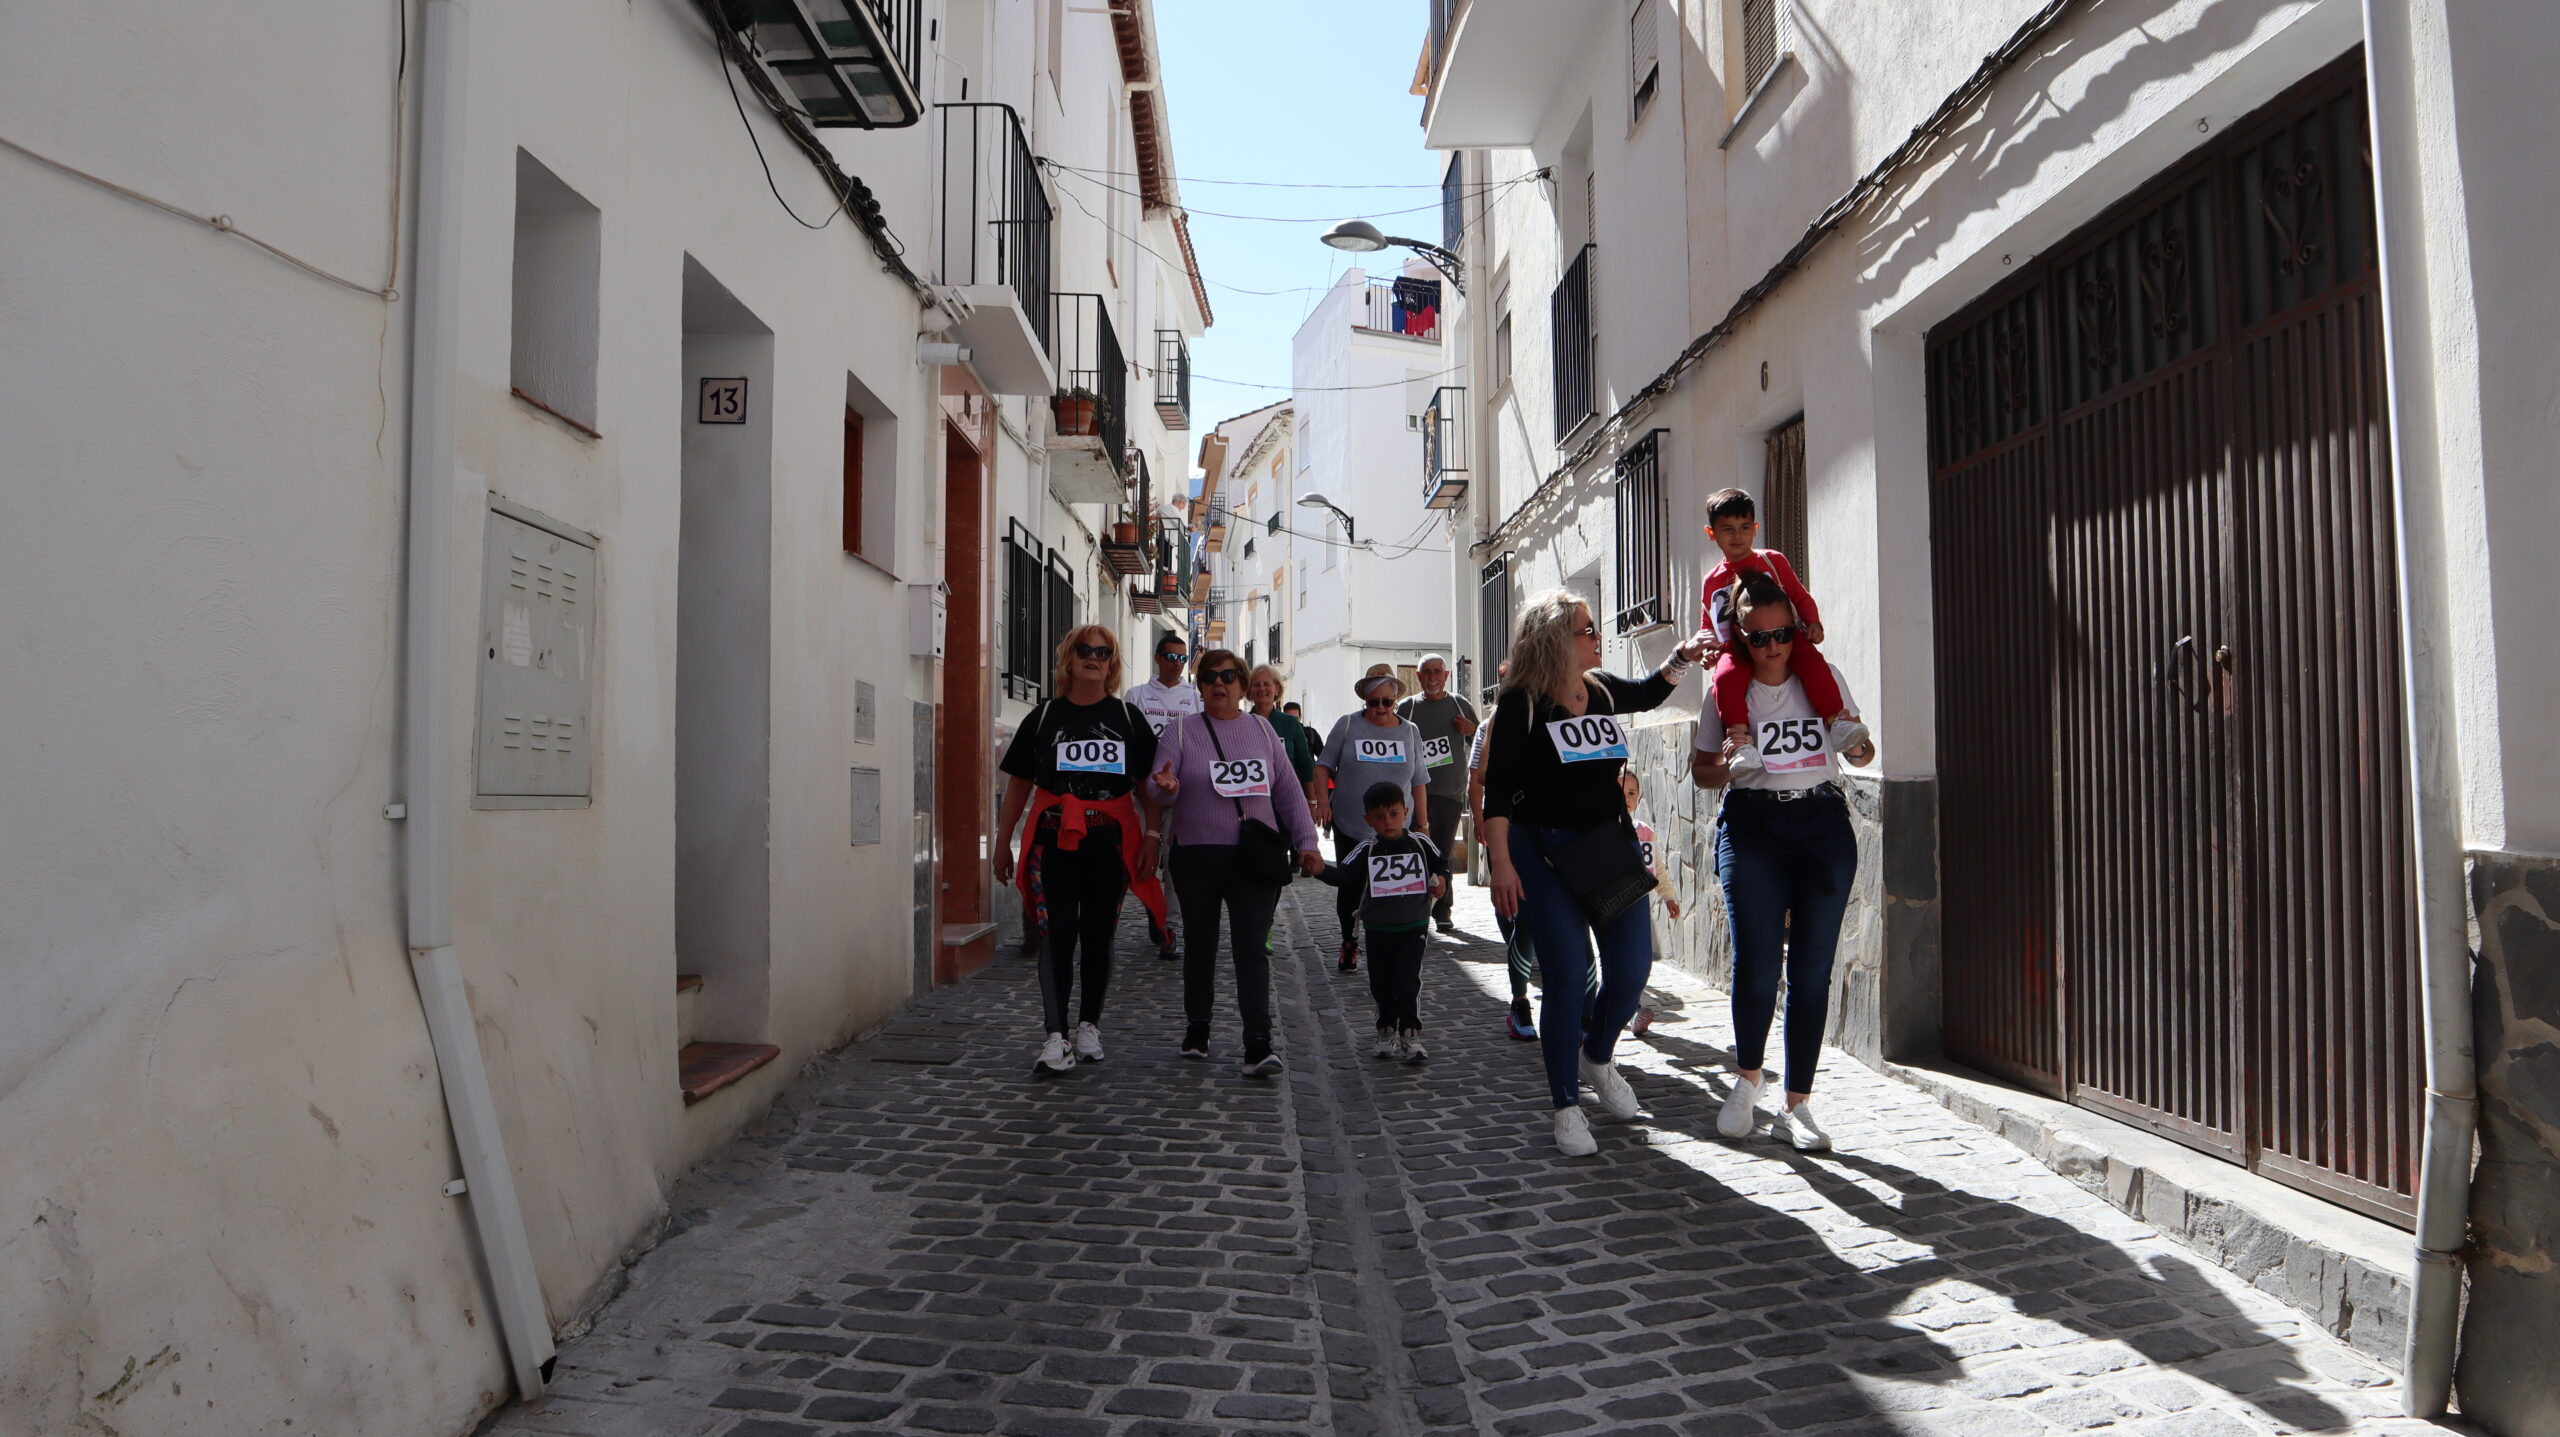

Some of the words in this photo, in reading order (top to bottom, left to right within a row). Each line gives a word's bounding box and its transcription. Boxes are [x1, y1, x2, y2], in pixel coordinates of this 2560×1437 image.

[1760, 360, 1769, 392] 6
[709, 387, 739, 416] 13
[1559, 717, 1618, 748] 009
[1762, 719, 1823, 755] 255
[1065, 741, 1119, 763] 008
[1362, 740, 1398, 756] 001
[1213, 759, 1265, 784] 293
[1372, 853, 1423, 882] 254
